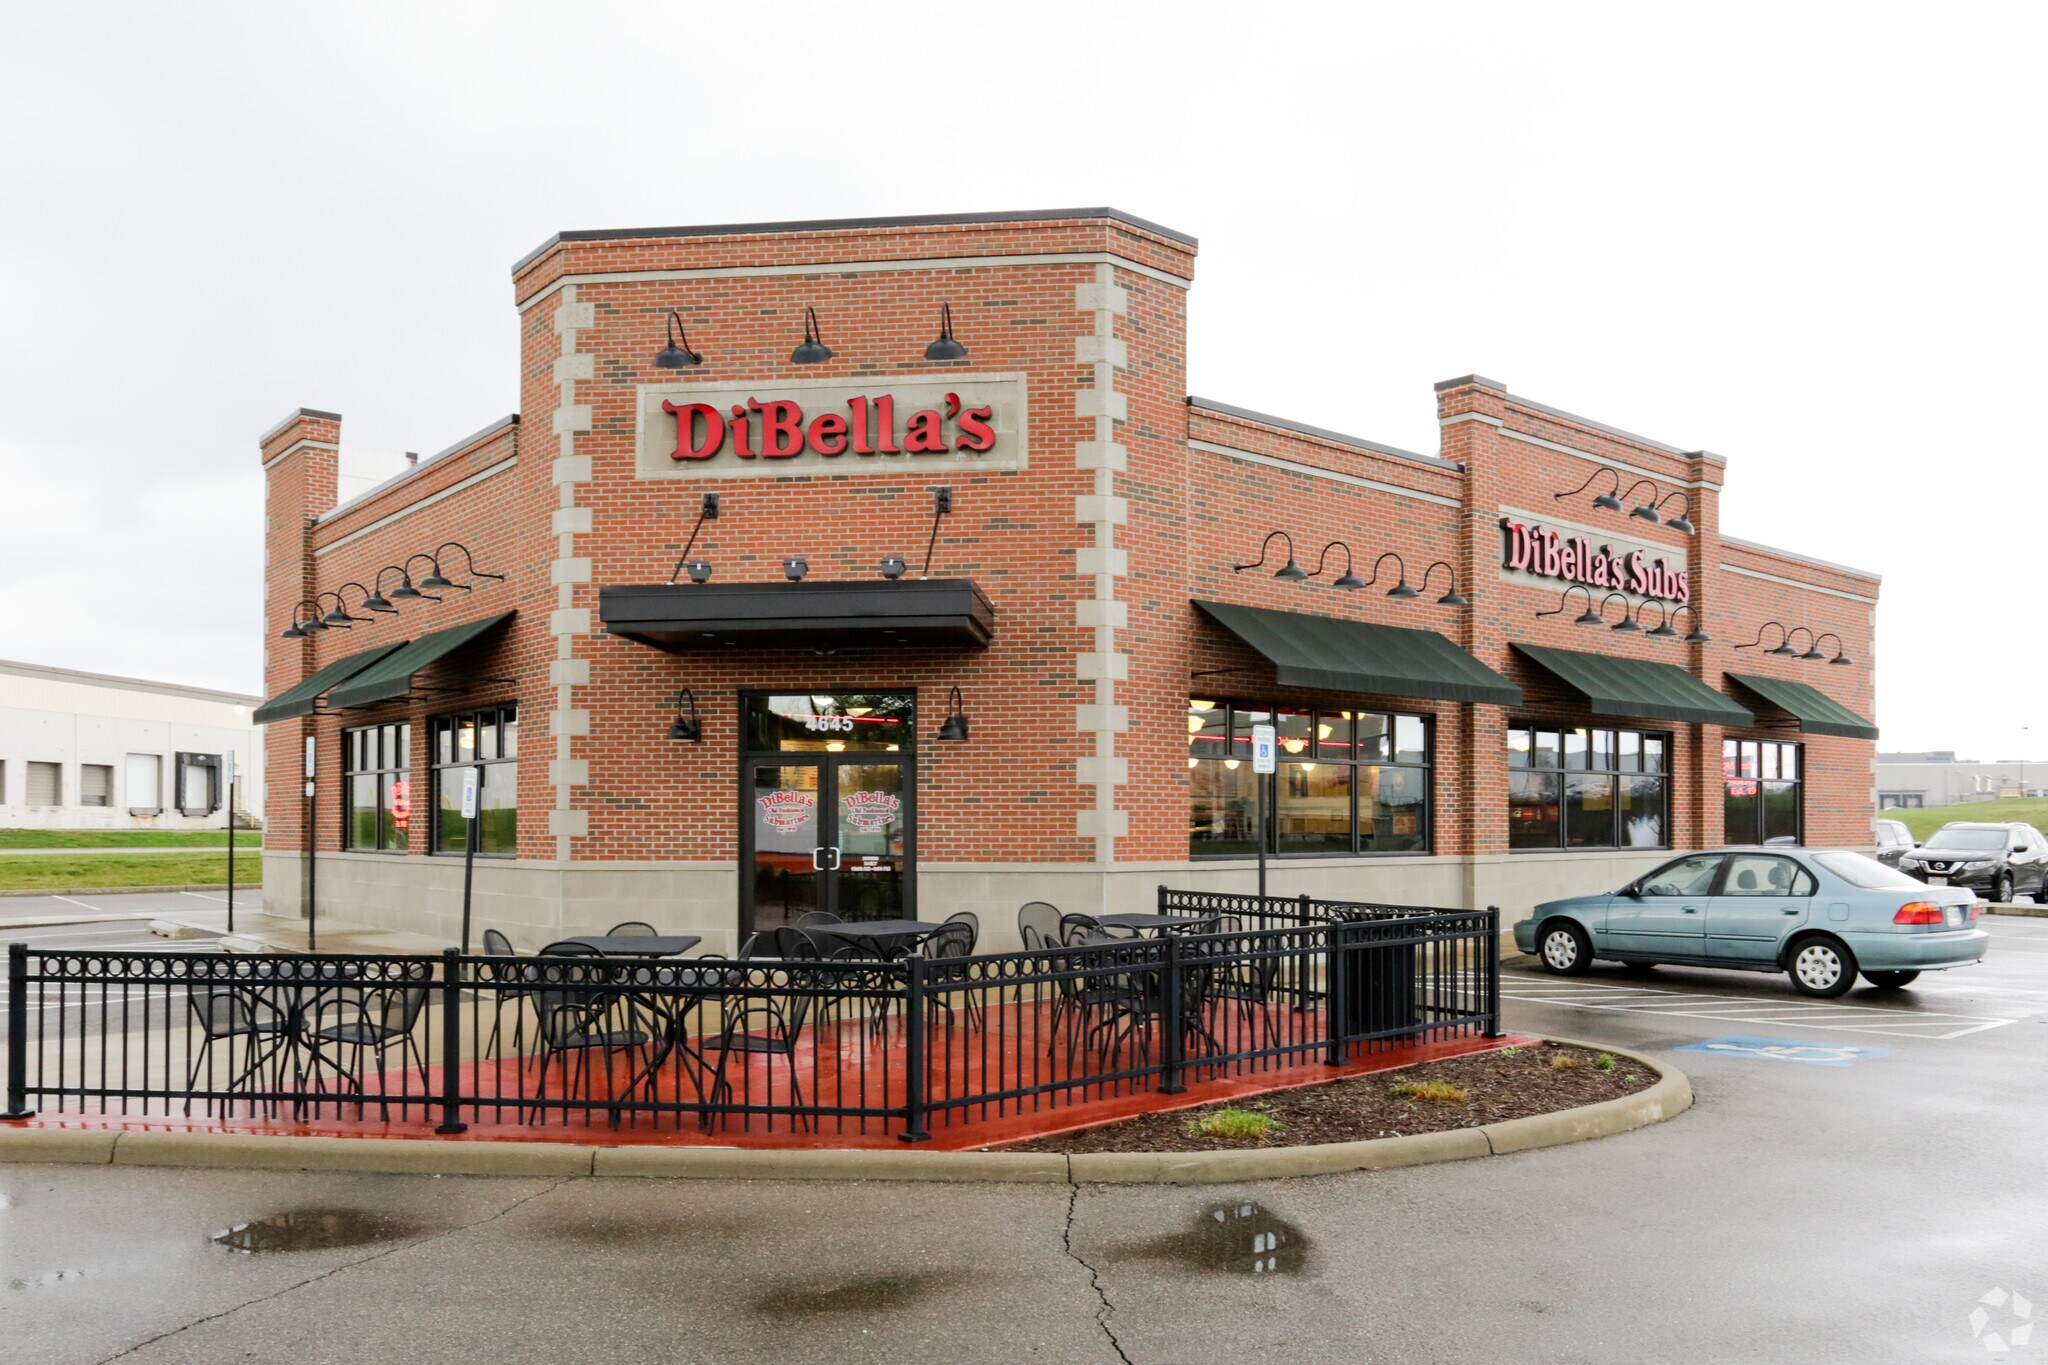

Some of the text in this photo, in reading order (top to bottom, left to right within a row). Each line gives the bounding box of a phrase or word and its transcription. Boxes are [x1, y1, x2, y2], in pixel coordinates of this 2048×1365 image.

[661, 392, 996, 462] DiBella's
[1501, 517, 1690, 602] DiBella's Subs
[805, 715, 854, 732] 4645
[758, 790, 814, 809] DiBella's
[842, 790, 900, 809] DiBella's
